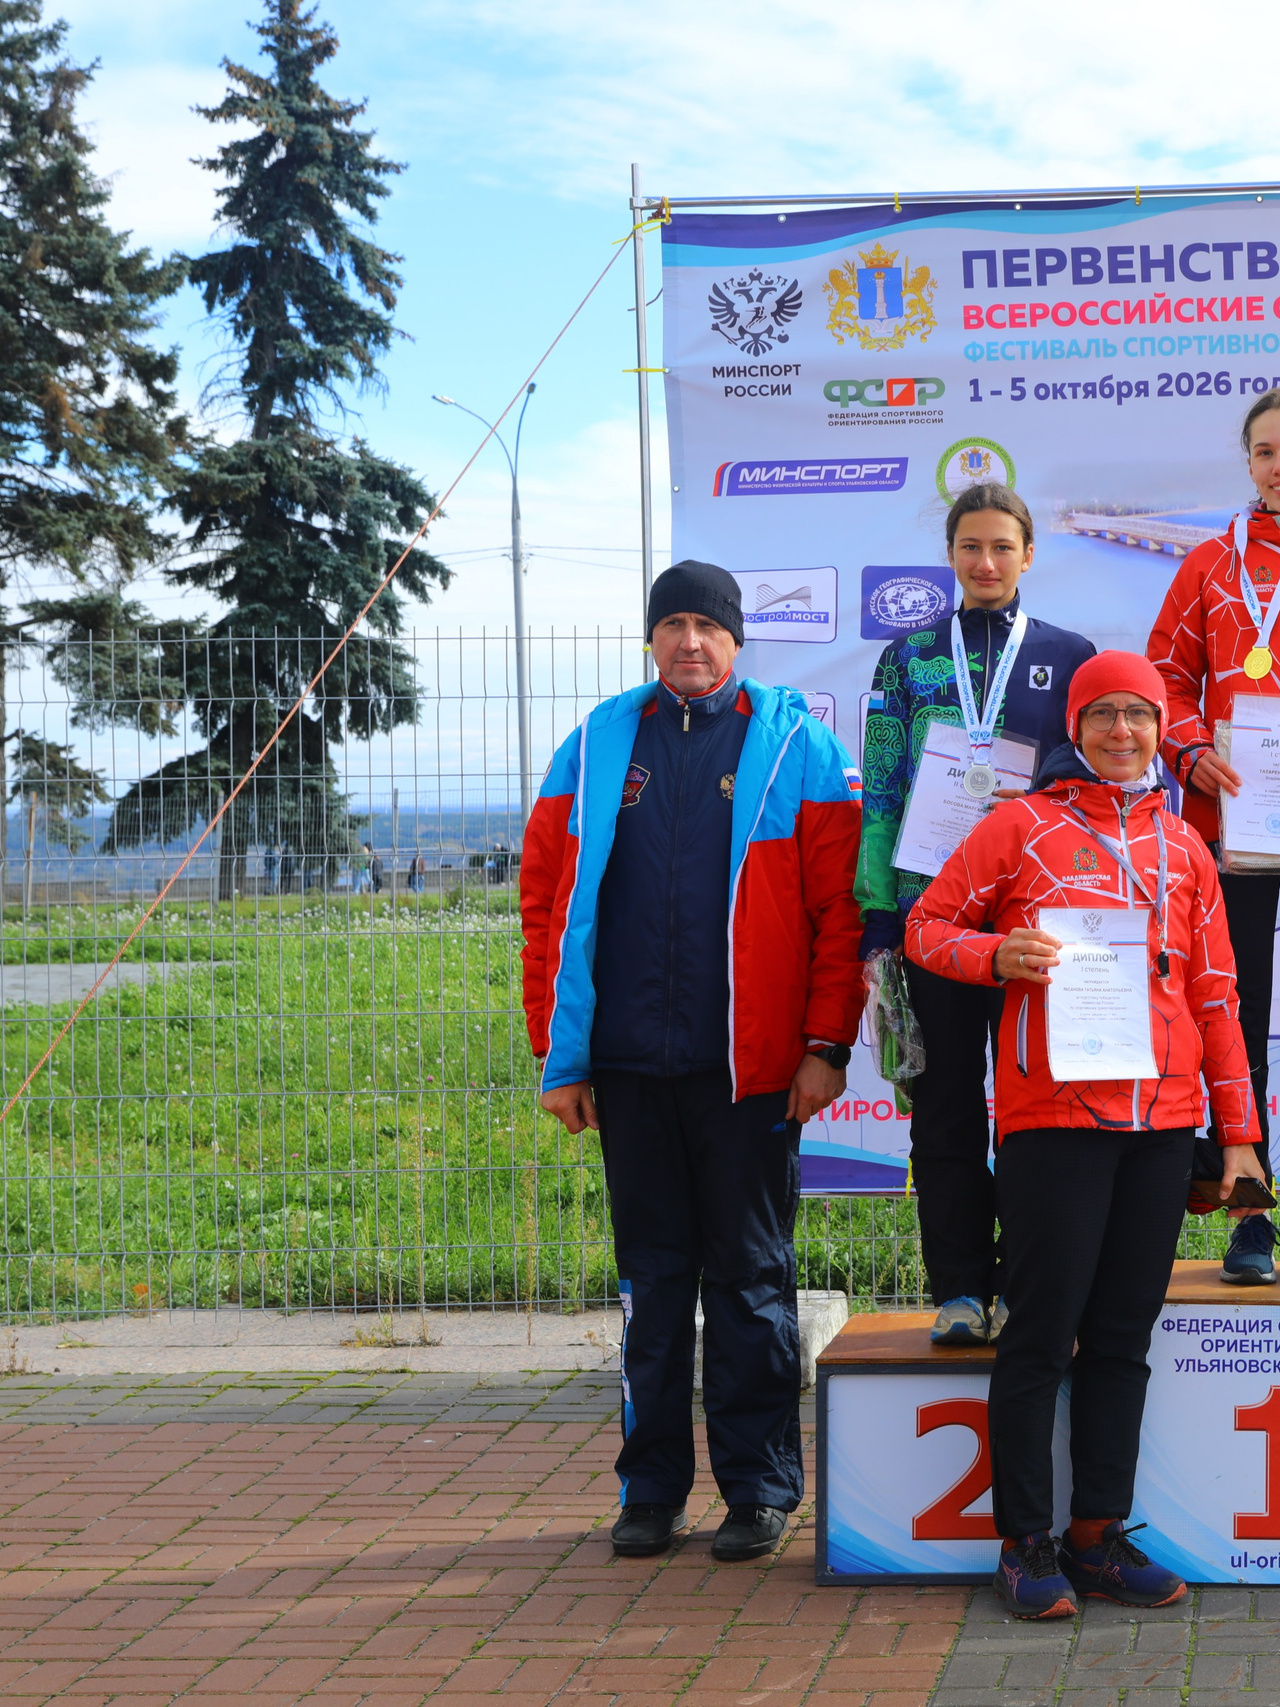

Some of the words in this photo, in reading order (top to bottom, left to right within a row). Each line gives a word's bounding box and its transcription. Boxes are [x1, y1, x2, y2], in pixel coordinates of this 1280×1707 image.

[963, 292, 1265, 330] ВСЕРОССИЙСКИЕ
[963, 338, 1117, 363] ФЕСТИВАЛЬ
[712, 364, 801, 378] МИНСПОРТ
[724, 383, 792, 397] РОССИИ
[1033, 374, 1149, 405] октября
[1157, 371, 1232, 397] 2026
[738, 463, 900, 482] МИНСПОРТ
[880, 577, 933, 591] ГЕОГРАФИЧЕСКОЕ
[1062, 874, 1111, 882] ВЛАДИМИРСКАЯ
[1072, 953, 1118, 963] ДИПЛОМ
[1161, 1318, 1272, 1336] ФЕДЕРАЦИЯ
[911, 1397, 1005, 1542] 2
